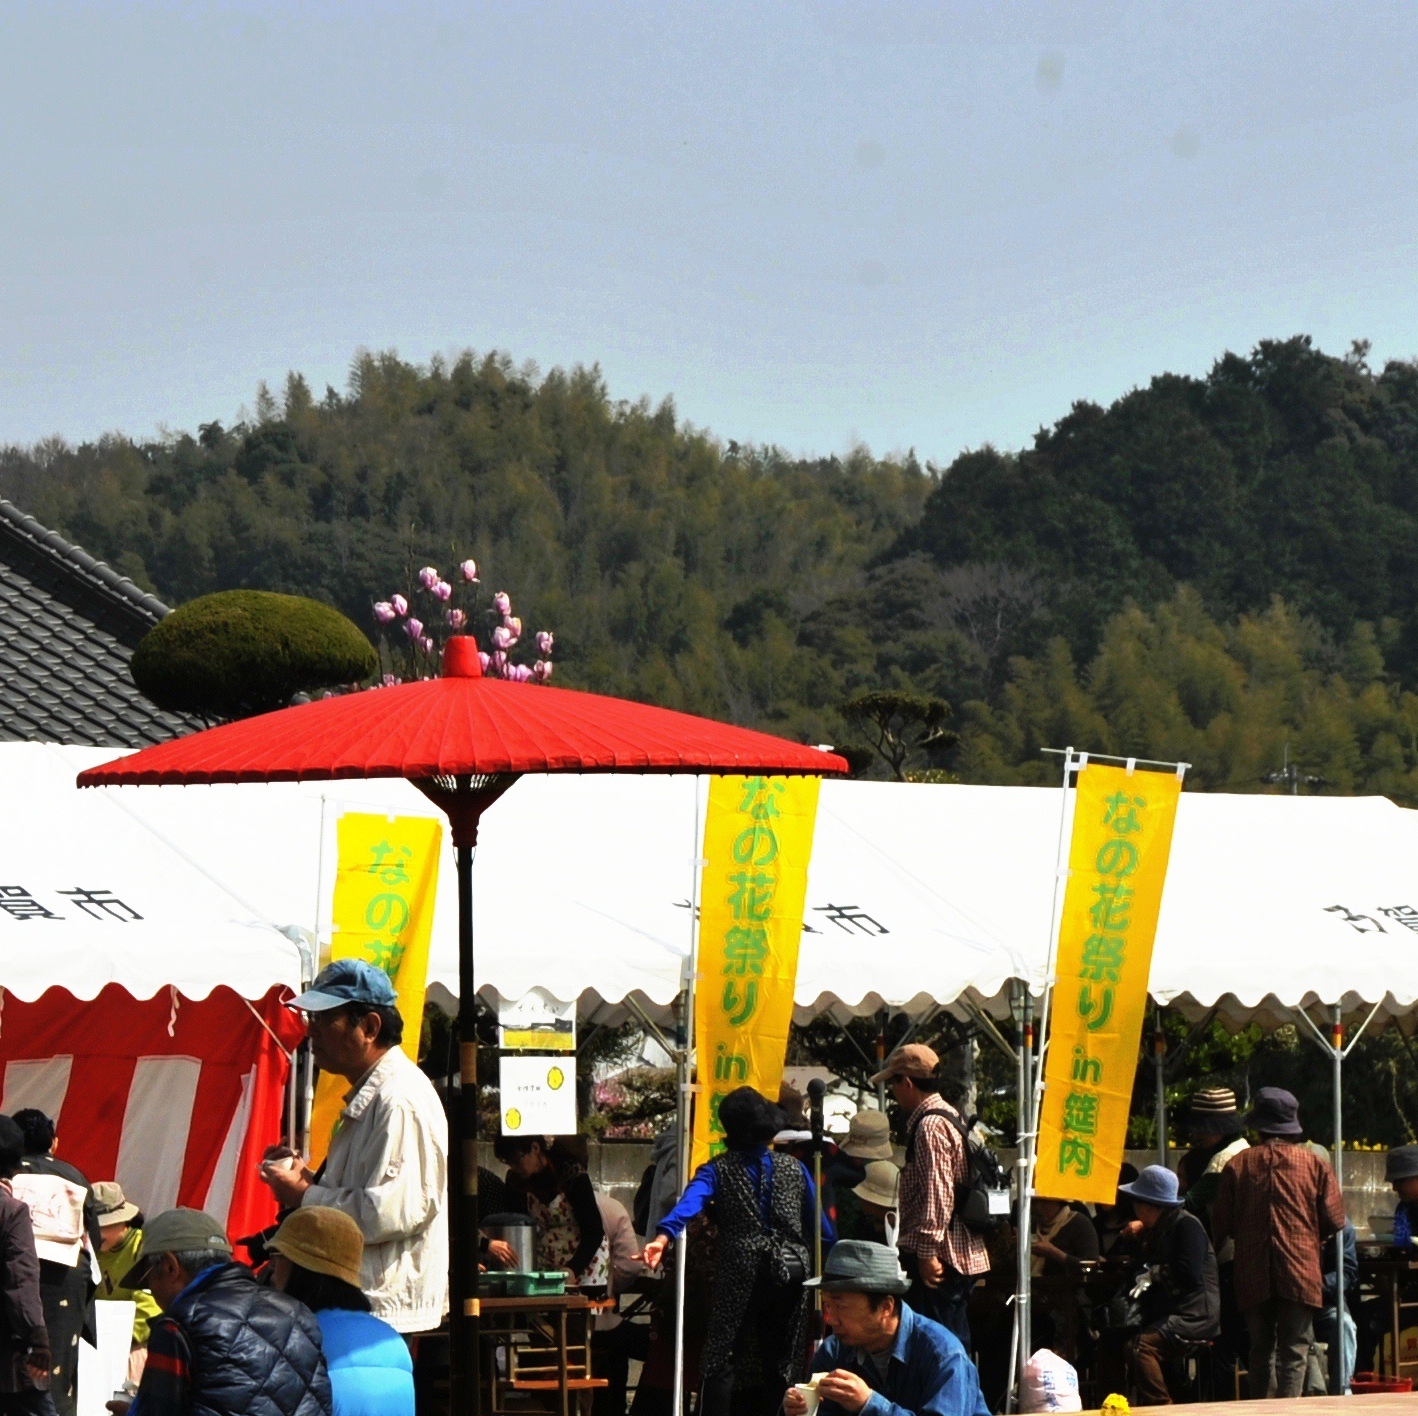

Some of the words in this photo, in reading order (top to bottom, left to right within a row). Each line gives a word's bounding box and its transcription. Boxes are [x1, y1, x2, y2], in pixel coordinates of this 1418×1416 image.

[722, 776, 787, 1027] なの花祭り
[1077, 790, 1147, 1033] なの花祭り
[713, 1043, 748, 1082] in
[1070, 1047, 1102, 1084] in
[1058, 1092, 1099, 1180] 筵内
